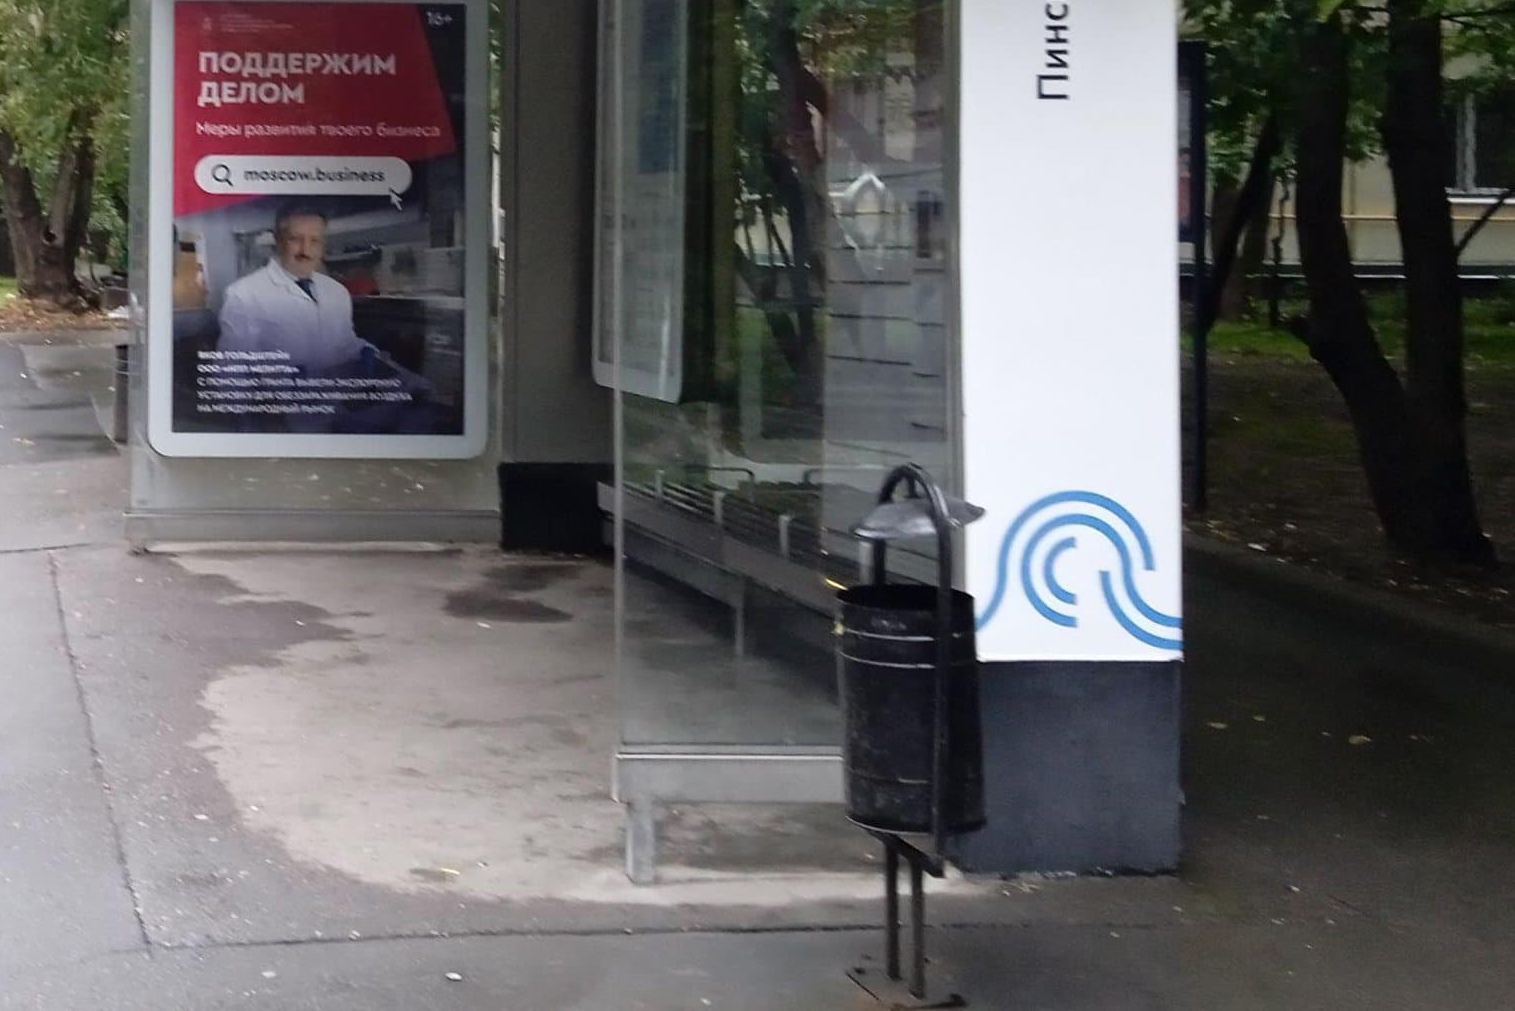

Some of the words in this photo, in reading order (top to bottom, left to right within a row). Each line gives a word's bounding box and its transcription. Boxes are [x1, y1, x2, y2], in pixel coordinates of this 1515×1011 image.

[197, 51, 396, 78] ПОДДЕРЖИМ
[197, 81, 305, 107] ДЕЛОМ
[196, 122, 241, 138] Меры
[244, 123, 317, 138] развития
[320, 124, 373, 137] твоего
[376, 121, 441, 137] бизнеса
[243, 166, 386, 183] moscow.business
